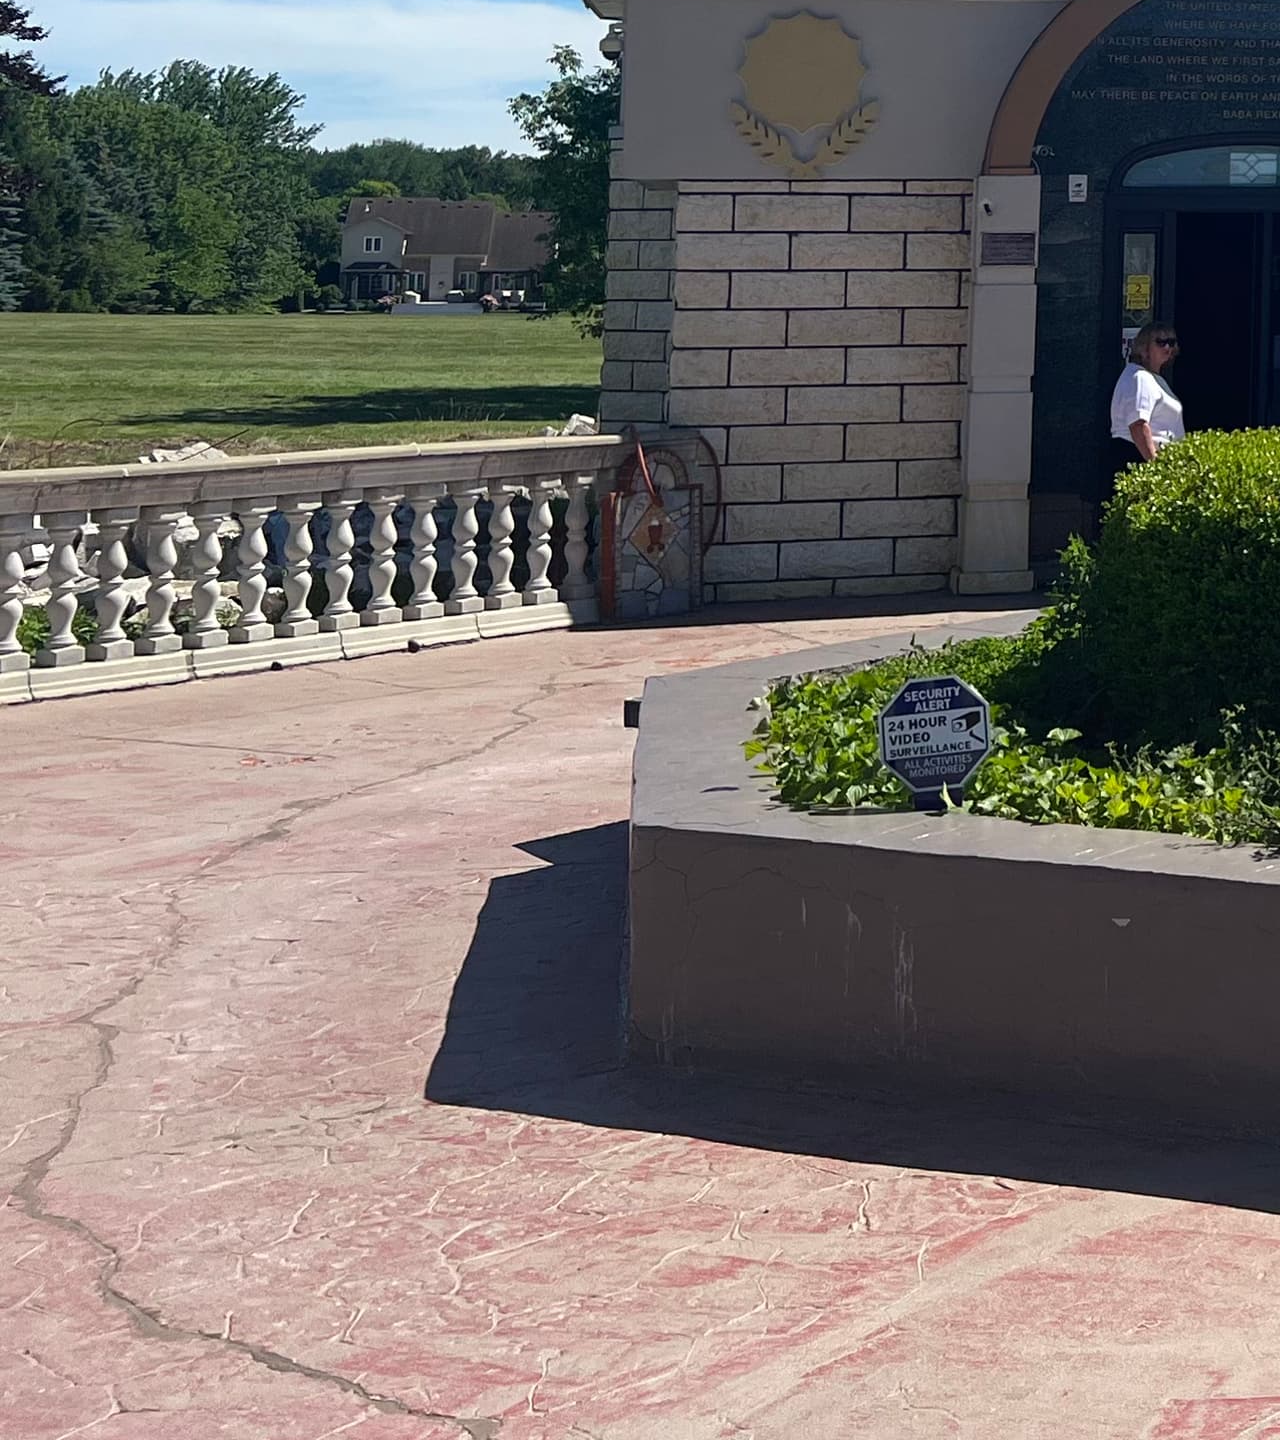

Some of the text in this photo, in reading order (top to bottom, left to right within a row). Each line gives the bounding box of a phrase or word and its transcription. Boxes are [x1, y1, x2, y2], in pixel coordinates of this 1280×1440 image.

[1166, 1, 1186, 10] THE
[1190, 2, 1231, 11] UNITED
[1164, 20, 1205, 29] WHERE
[1209, 20, 1224, 30] WE
[1231, 21, 1259, 31] HAVE
[1109, 37, 1129, 46] ALL
[1132, 36, 1150, 46] ITS
[1153, 37, 1226, 48] GENEROSITY
[1233, 39, 1257, 49] AND
[1108, 54, 1129, 64] THE
[1134, 55, 1164, 65] LAND
[1167, 55, 1209, 65] WHERE
[1211, 56, 1229, 65] WE
[1232, 56, 1265, 66] FIRST
[1166, 73, 1178, 82] IN
[1182, 73, 1203, 83] THE
[1206, 74, 1248, 84] WORDS
[1252, 74, 1266, 84] OF
[1071, 90, 1096, 100] MAY
[1101, 90, 1137, 100] THERE
[1141, 91, 1157, 100] BE
[1160, 91, 1198, 101] PEACE
[1200, 91, 1217, 101] ON
[1221, 92, 1258, 101] EARTH
[1223, 110, 1252, 119] BABA
[904, 686, 960, 702] SECURITY
[915, 698, 951, 713] ALERT
[888, 716, 947, 732] 24 HOUR
[889, 732, 930, 746] VIDEO
[890, 741, 972, 758] SURVEILLANCE
[904, 754, 973, 770] ALL ACTIVITIES
[909, 764, 966, 777] MONITORED
